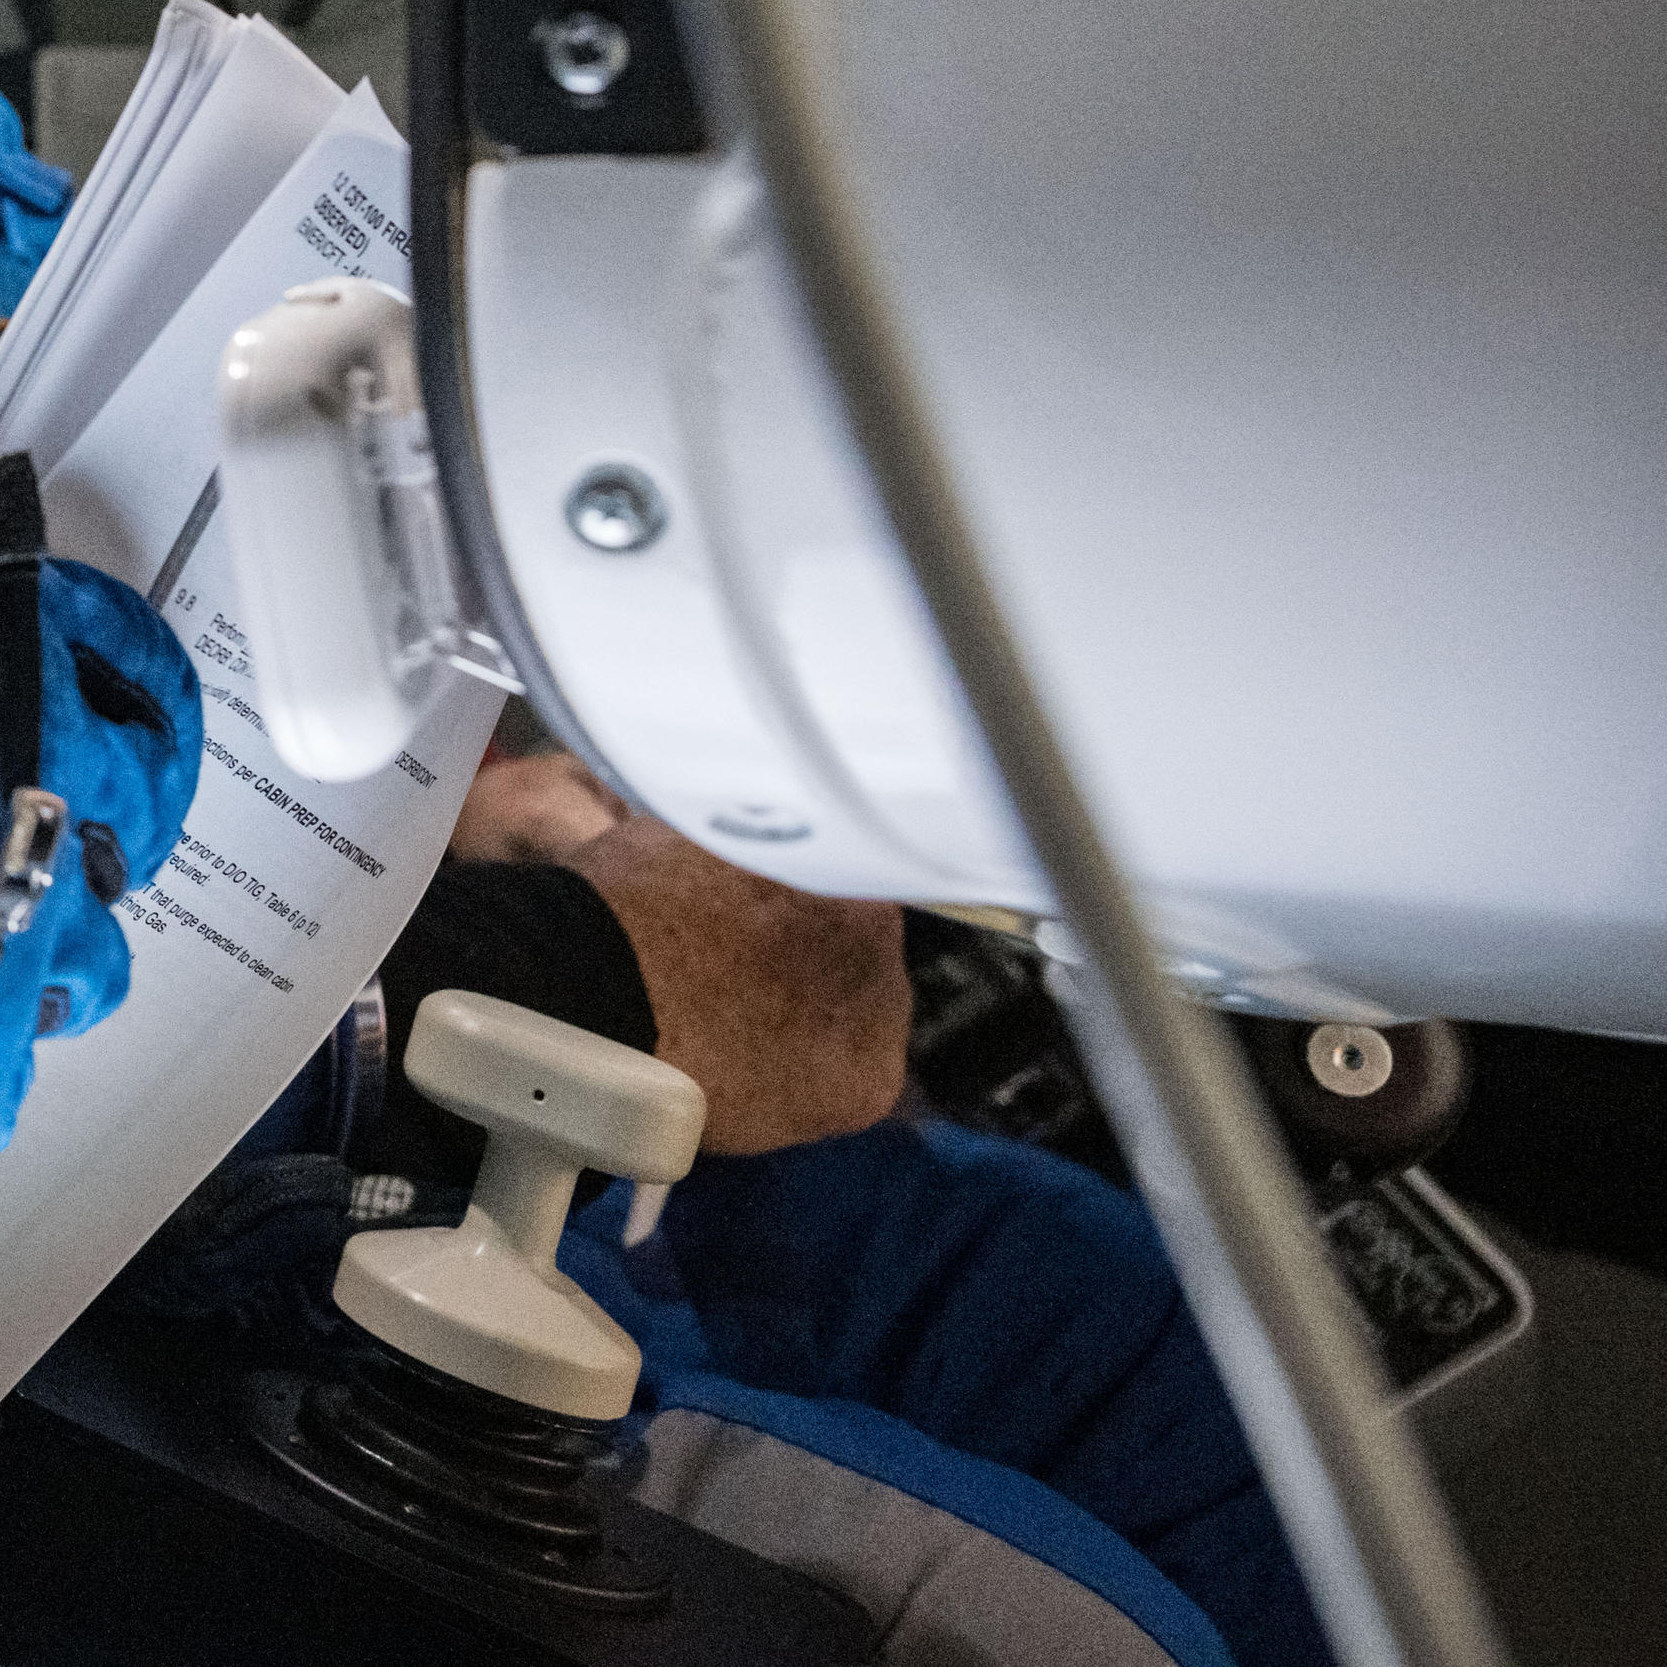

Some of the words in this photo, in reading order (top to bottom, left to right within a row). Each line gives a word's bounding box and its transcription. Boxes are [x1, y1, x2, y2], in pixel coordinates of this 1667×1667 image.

[233, 764, 257, 784] per
[254, 777, 293, 810] CABIN
[287, 802, 319, 828] PREP
[313, 822, 338, 845] FOR
[333, 836, 387, 879] CONTINGENCY
[186, 840, 216, 861] prior
[168, 852, 211, 888] required:
[211, 855, 226, 870] to
[222, 863, 247, 884] D/O
[264, 892, 291, 918] Table
[145, 912, 168, 935] Gas.
[287, 910, 300, 923] 6
[291, 914, 307, 931] (p
[150, 888, 174, 910] that
[167, 903, 200, 928] purge
[196, 923, 244, 957] expected
[237, 949, 250, 964] to
[247, 959, 274, 981] clean
[271, 975, 295, 994] cabin
[304, 920, 322, 941] 12)
